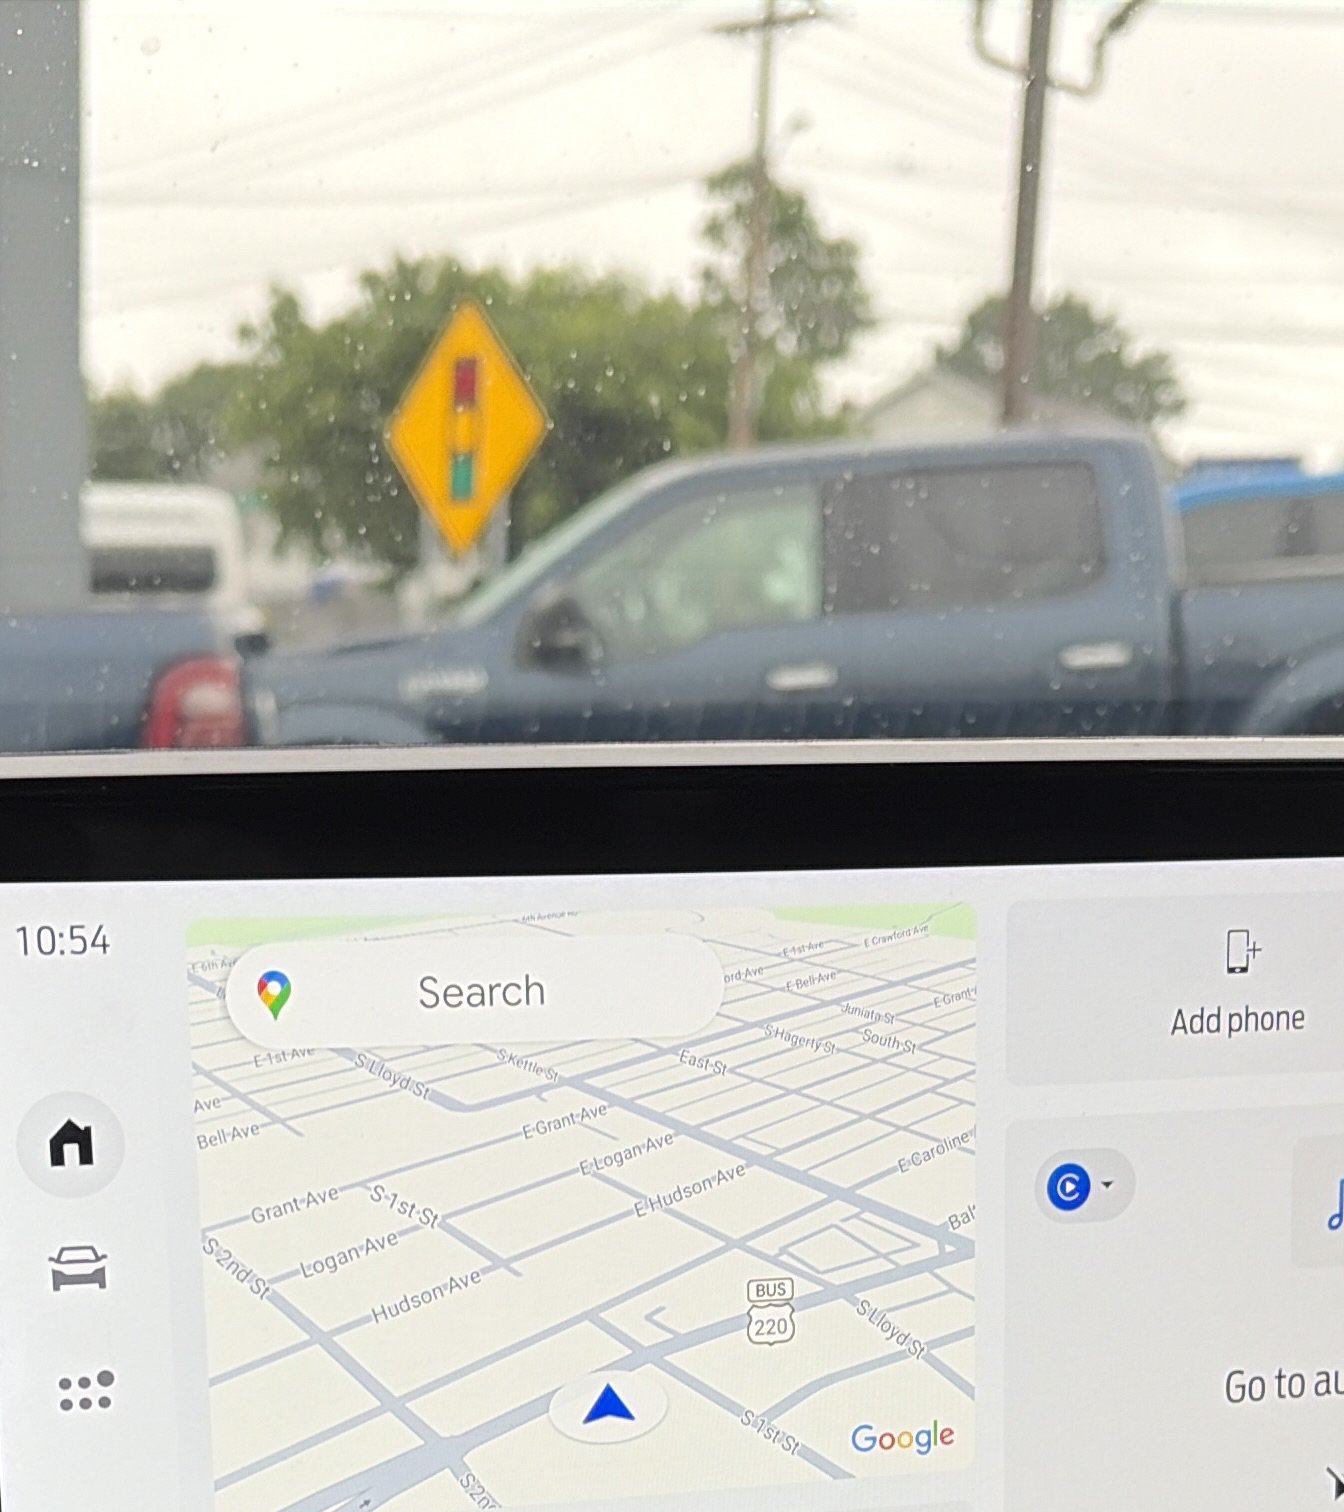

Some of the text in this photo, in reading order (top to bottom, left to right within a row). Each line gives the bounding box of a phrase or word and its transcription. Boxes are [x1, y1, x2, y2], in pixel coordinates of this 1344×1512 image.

[16, 924, 111, 956] 10:54
[419, 973, 546, 1010] Search
[724, 969, 741, 983] ord
[943, 987, 971, 1005] Grant
[841, 1003, 895, 1025] Juniata St
[1170, 1005, 1305, 1038] Add phone
[764, 1024, 836, 1055] S Hagerty St
[862, 1029, 917, 1055] South St
[355, 1054, 430, 1100] S Lloyd St
[497, 1049, 559, 1083] S Kettle St
[679, 1050, 728, 1077] East St
[193, 1096, 222, 1113] Ave
[523, 1104, 608, 1139] E Grant Ave
[196, 1123, 260, 1150] Bell Ave
[579, 1132, 674, 1176] E Logan Ave
[897, 1131, 970, 1173] E Caroline
[251, 1186, 340, 1224] Grant Ave
[370, 1185, 439, 1229] S 1st St
[634, 1163, 746, 1217] E Hudson Ave
[202, 1238, 270, 1300] S 2nd St
[300, 1231, 399, 1279] Logan Ave
[371, 1269, 482, 1324] Hudson Ave
[755, 1282, 787, 1298] BUS
[754, 1319, 788, 1336] 220
[856, 1301, 926, 1359] S Lloyd St
[1225, 1369, 1266, 1403] Go
[1274, 1367, 1306, 1399] to
[740, 1411, 800, 1456] S 1st St
[851, 1420, 955, 1455] Google
[460, 1473, 475, 1488] S
